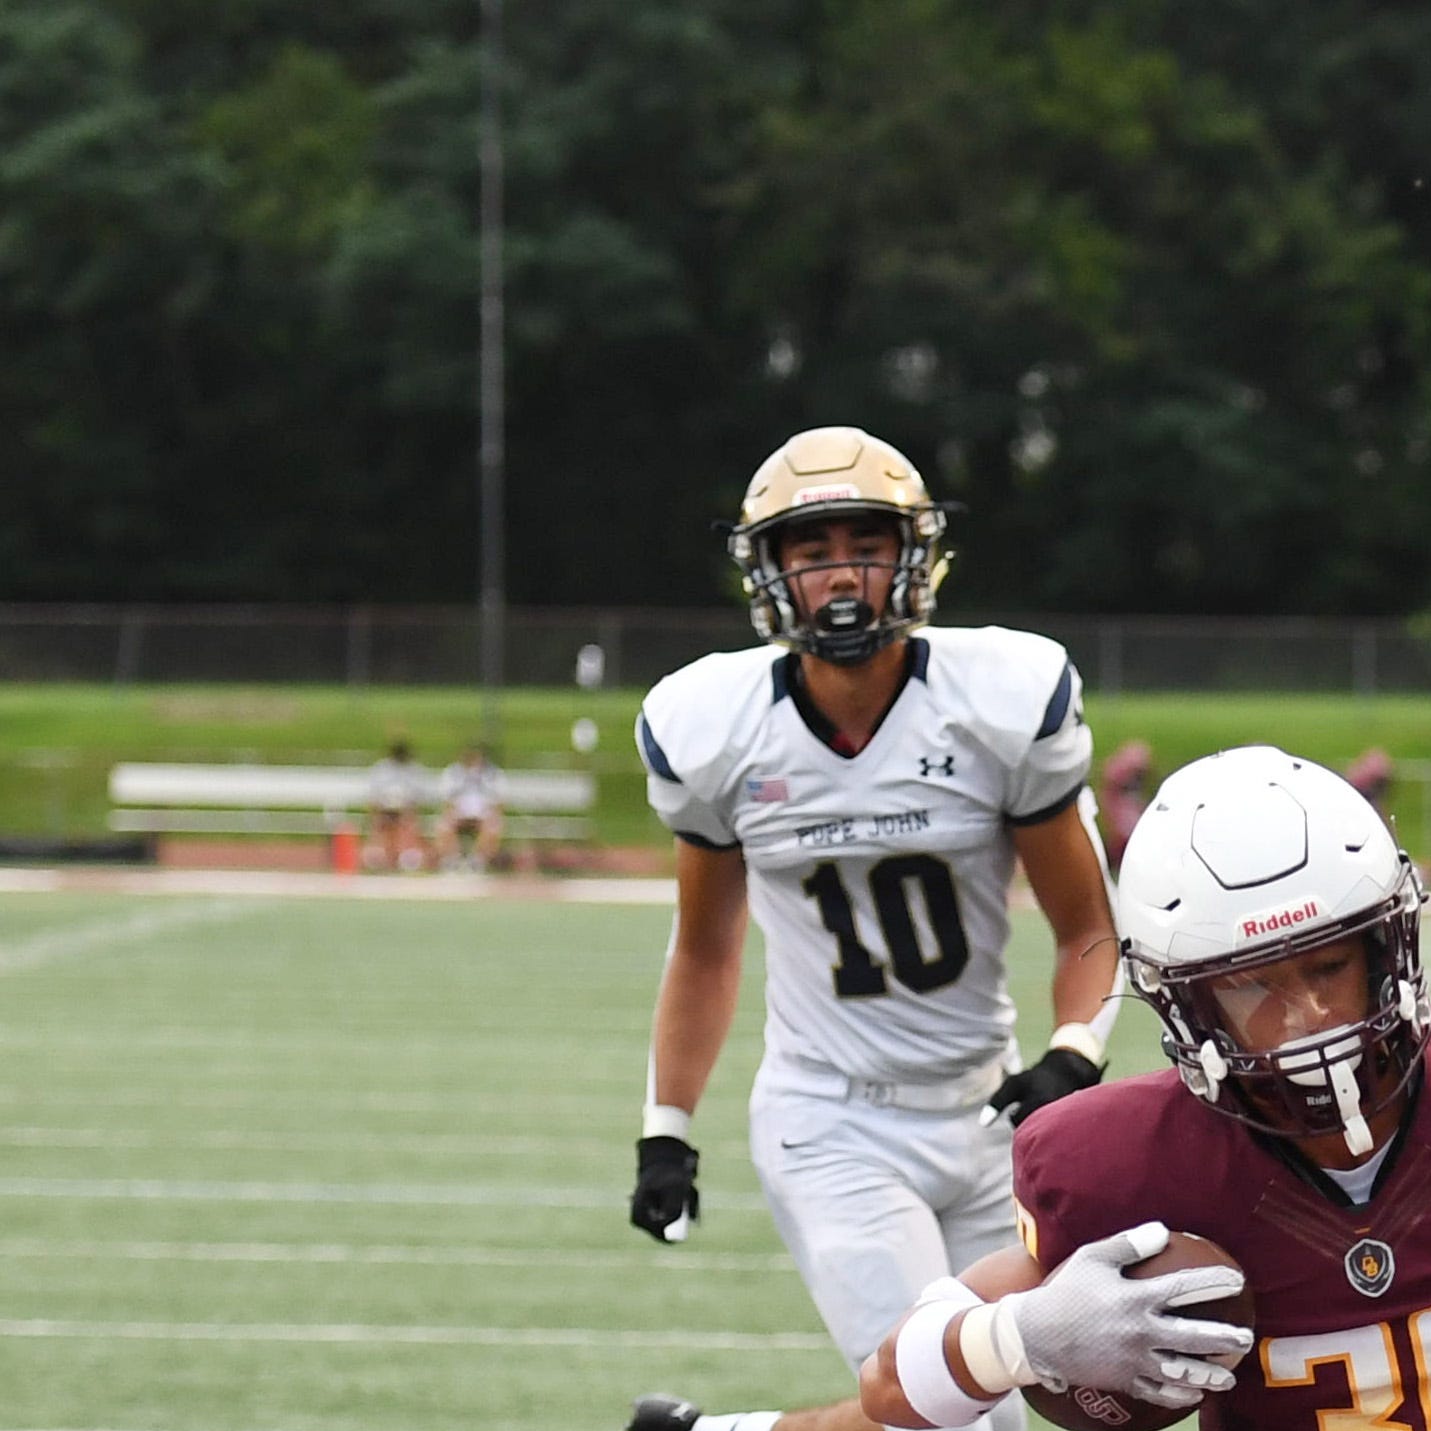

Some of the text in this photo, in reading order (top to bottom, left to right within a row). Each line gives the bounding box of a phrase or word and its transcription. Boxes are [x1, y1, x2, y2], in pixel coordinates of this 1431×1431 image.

[795, 810, 931, 845] POPE JOHN
[802, 853, 970, 997] 10
[1242, 901, 1318, 938] Riddell
